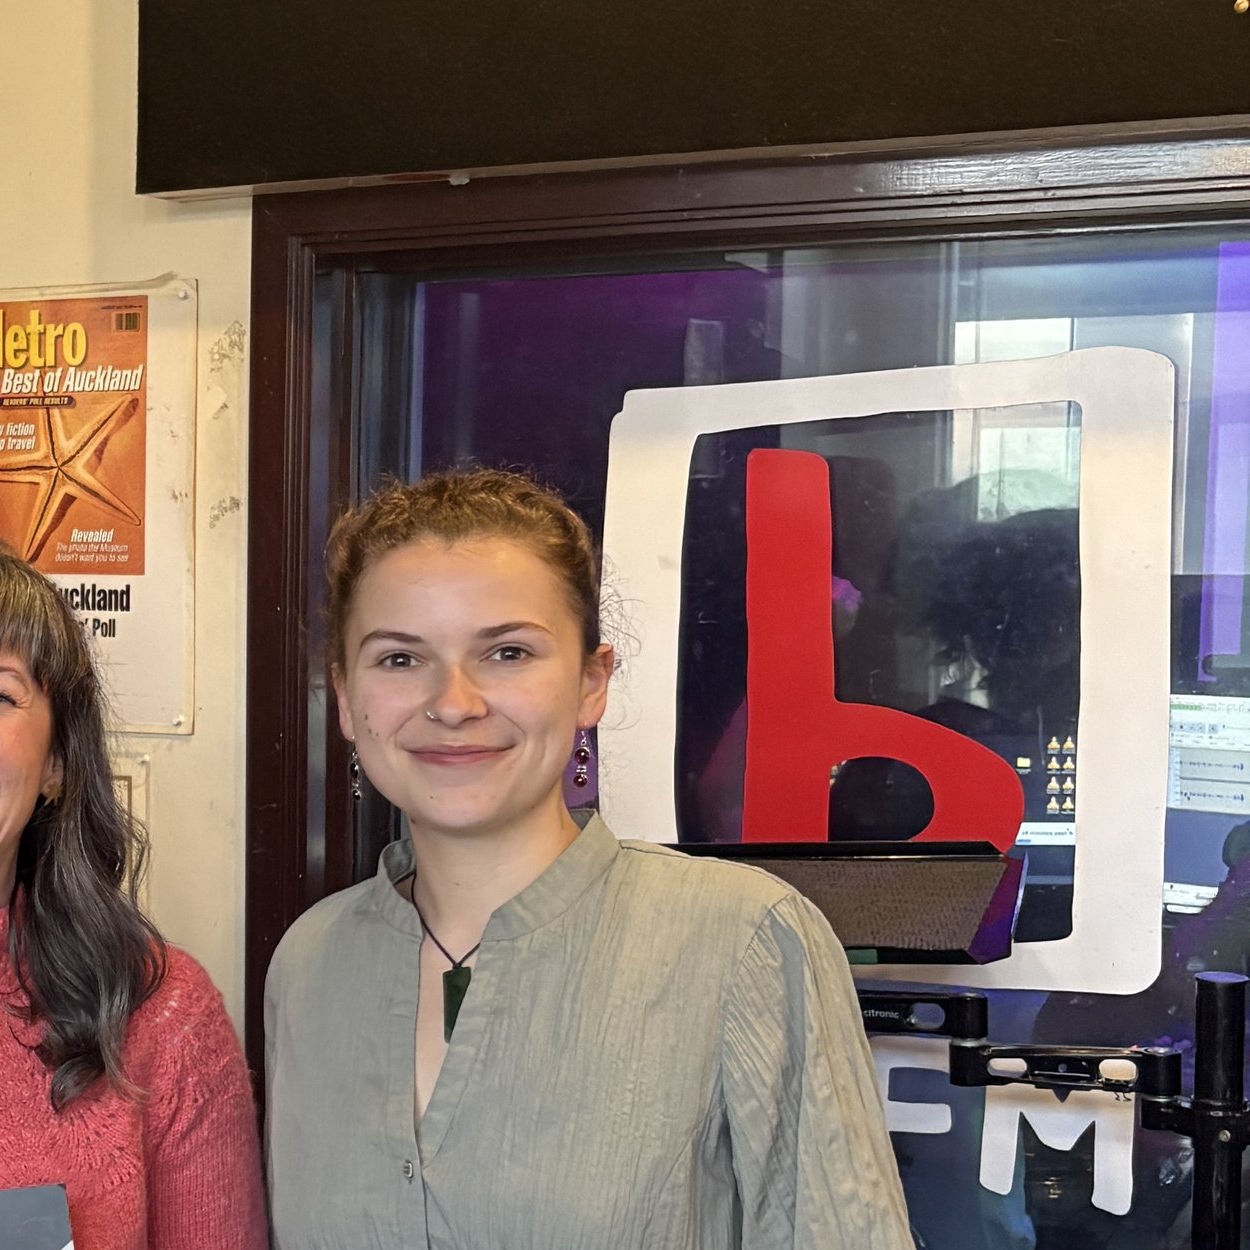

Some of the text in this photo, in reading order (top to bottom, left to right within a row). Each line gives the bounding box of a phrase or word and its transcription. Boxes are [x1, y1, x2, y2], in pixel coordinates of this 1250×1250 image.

[1, 368, 42, 394] Best
[44, 367, 63, 393] of
[62, 365, 144, 392] Auckland
[6, 422, 35, 436] fiction
[7, 436, 36, 450] travel
[71, 528, 114, 543] Revealed
[59, 583, 131, 612] uckland
[92, 618, 116, 638] Poll
[863, 1009, 900, 1019] citronic
